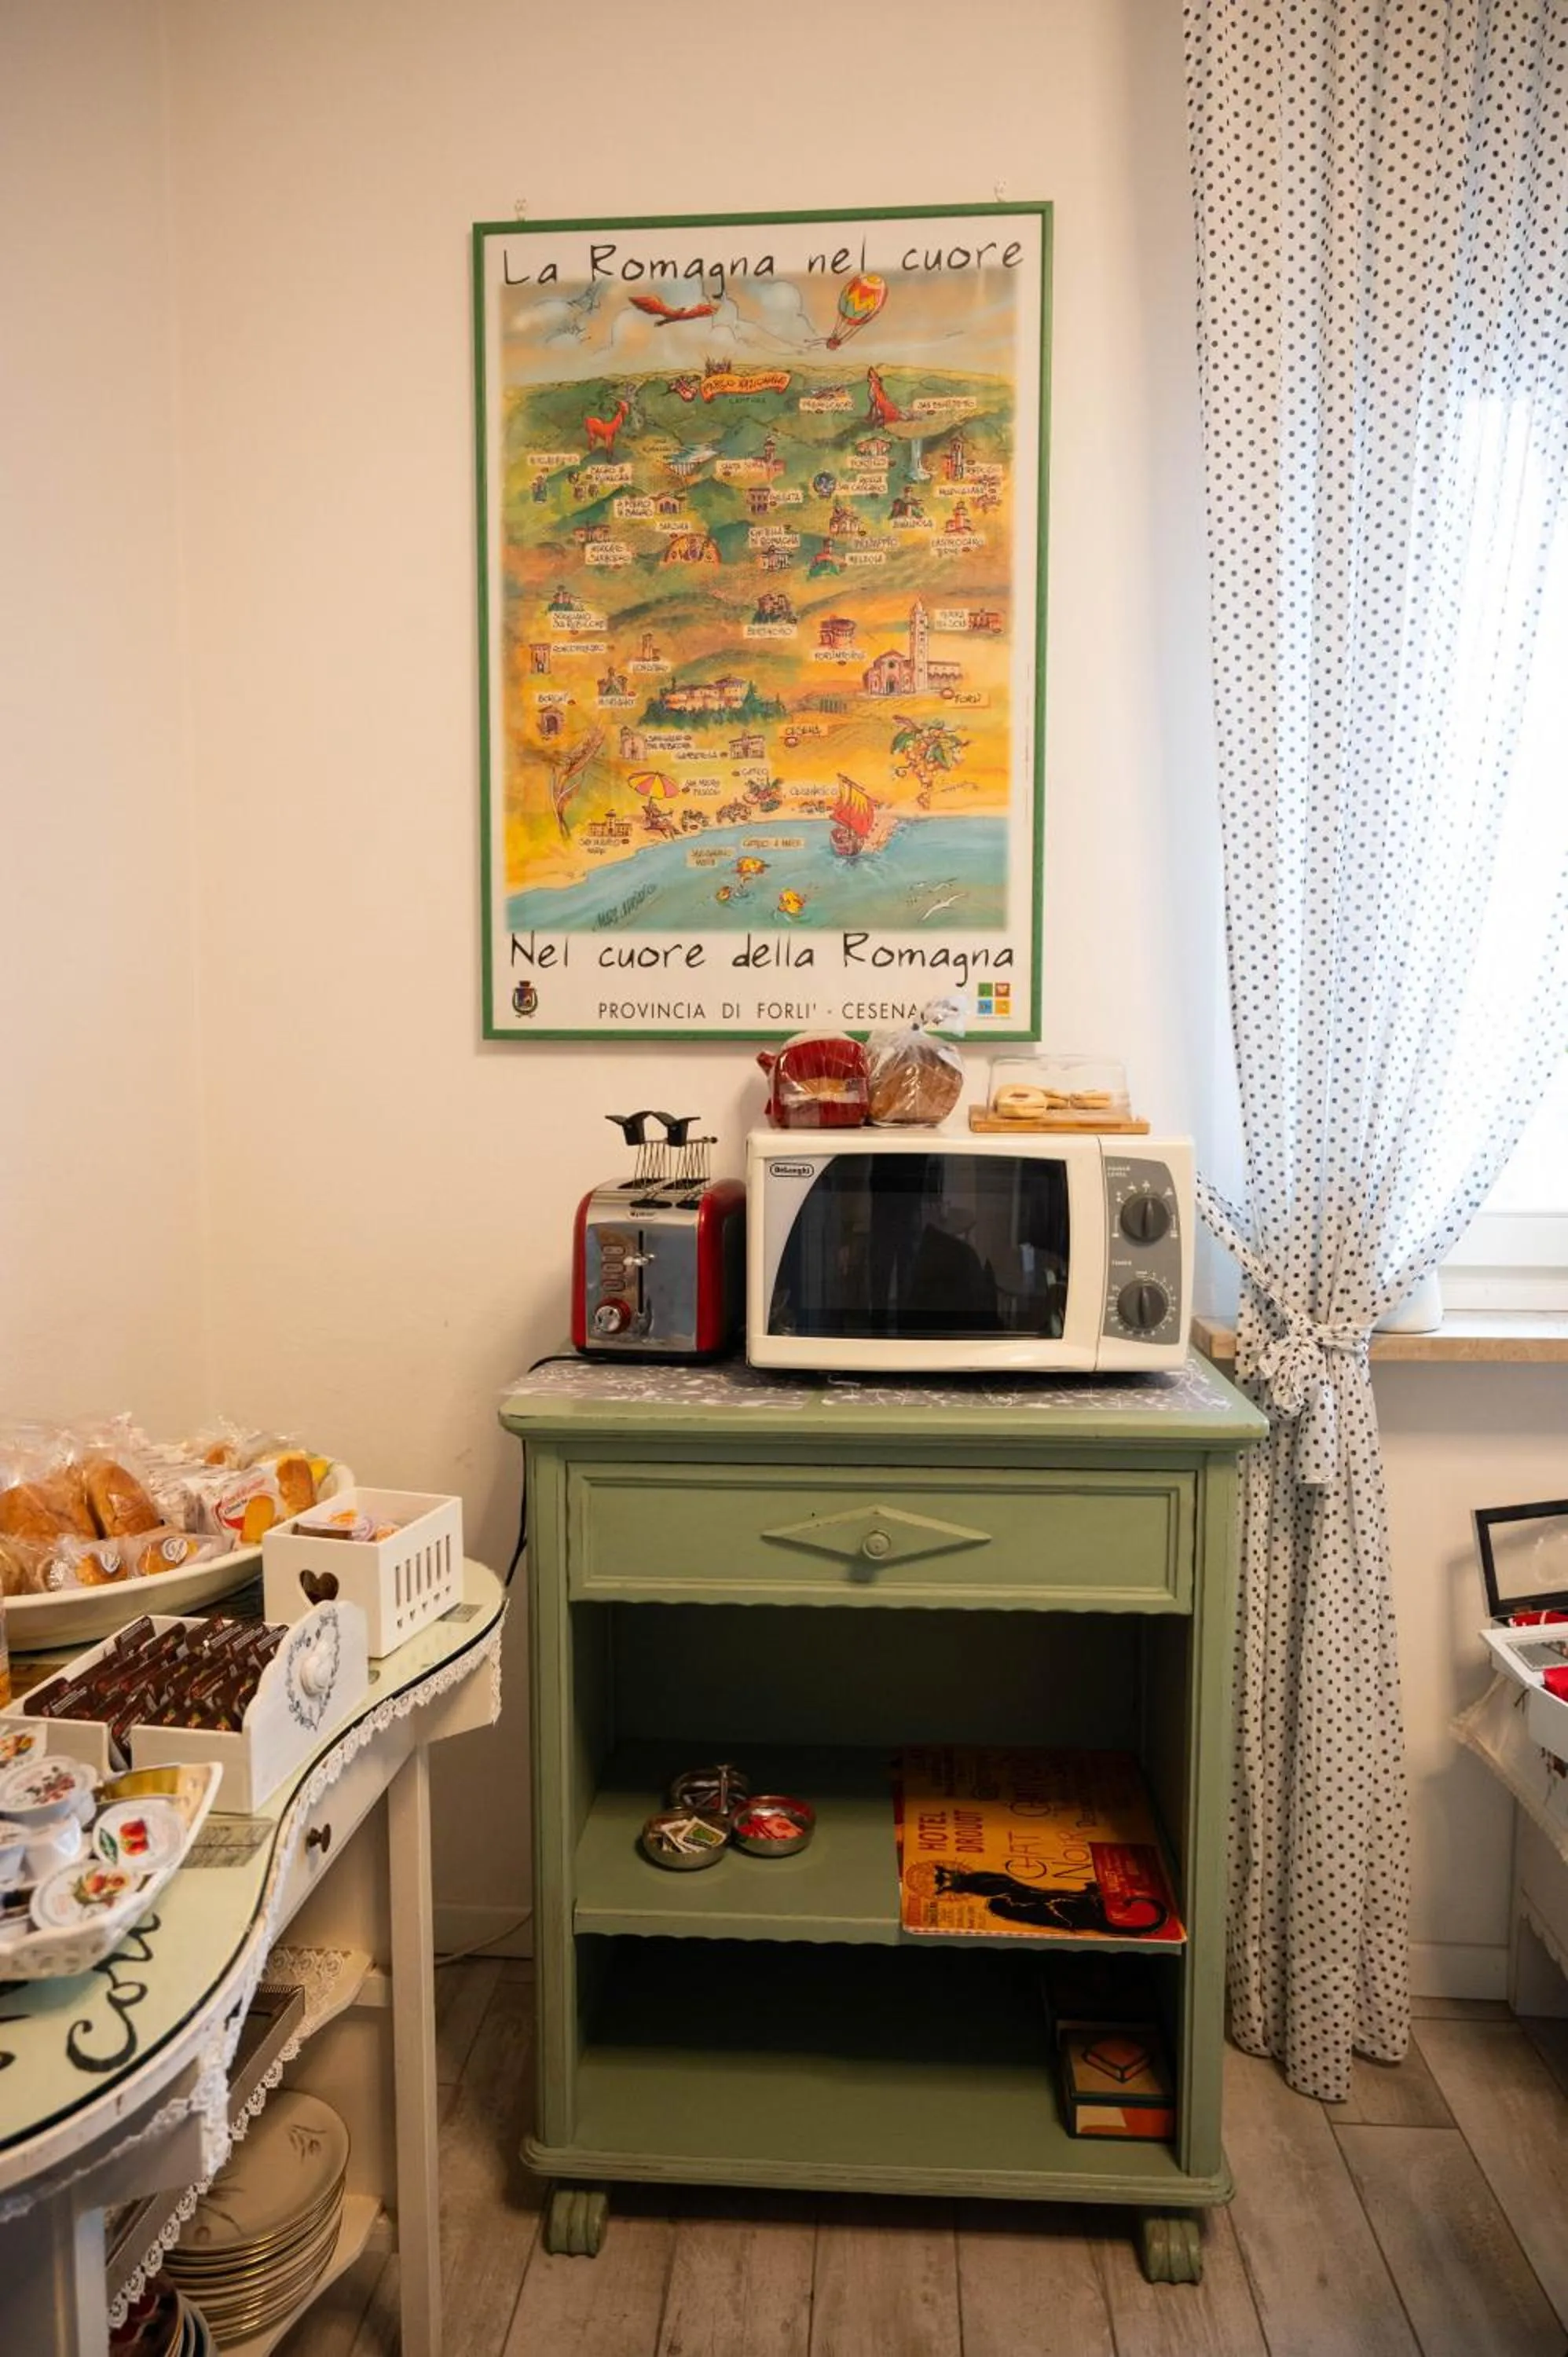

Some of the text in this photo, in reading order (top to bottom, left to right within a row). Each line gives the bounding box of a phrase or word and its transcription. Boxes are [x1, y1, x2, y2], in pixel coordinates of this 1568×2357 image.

[503, 236, 1024, 299] La Romagna nel cuore
[511, 929, 1014, 988] Nel cuore della Romagna
[599, 1002, 705, 1019] PROVINCIA
[722, 1002, 740, 1019] DI
[757, 1002, 816, 1019] FORLI'
[841, 1002, 918, 1019] CESENA
[918, 1809, 947, 1852] HOTEL
[954, 1809, 985, 1854] DROUOT
